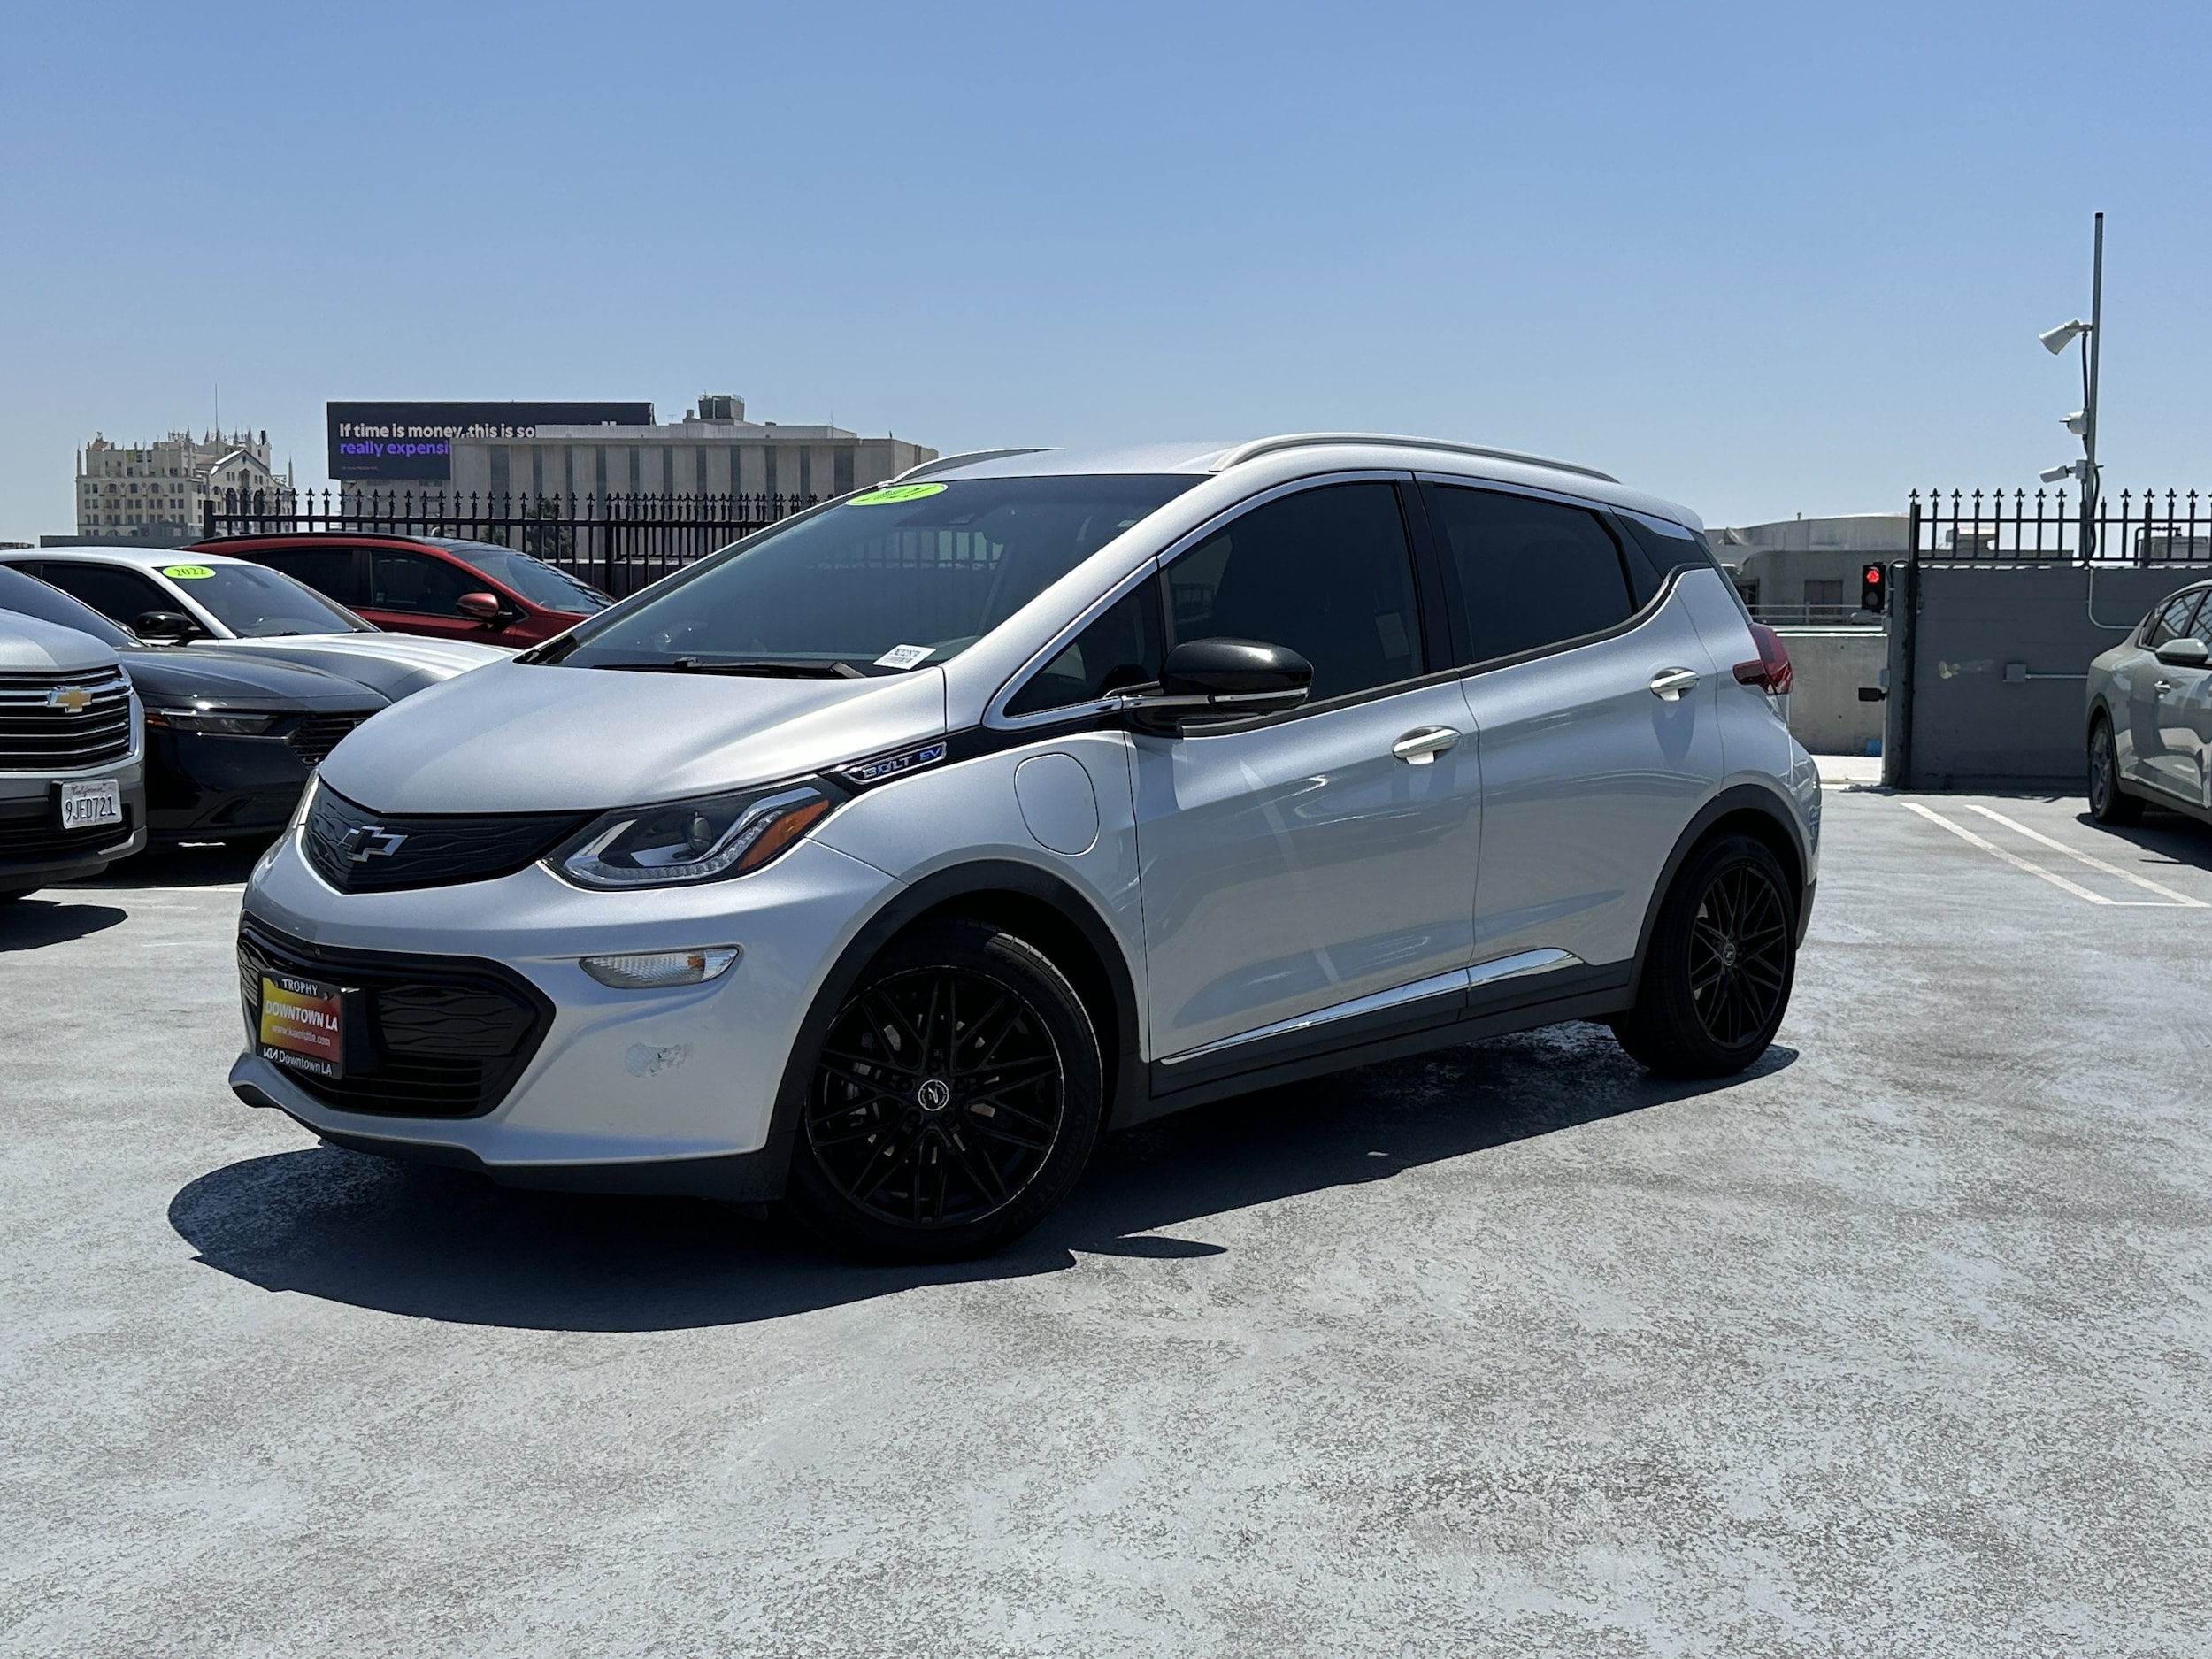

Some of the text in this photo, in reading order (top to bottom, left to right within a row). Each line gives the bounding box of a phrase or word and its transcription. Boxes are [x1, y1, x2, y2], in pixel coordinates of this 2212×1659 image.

[340, 422, 354, 438] If
[354, 422, 389, 439] time
[392, 422, 405, 439] is
[467, 422, 498, 439] this
[500, 423, 514, 439] is
[516, 426, 535, 439] so
[340, 440, 452, 457] really expensi
[173, 567, 206, 576] 2022
[862, 747, 941, 779] BOLT EV
[65, 796, 116, 822] 9JED721
[281, 978, 319, 996] TROPHY
[265, 1000, 339, 1032] DOWNTOWN LA
[279, 1049, 320, 1073] Downtown
[321, 1063, 333, 1076] LA
